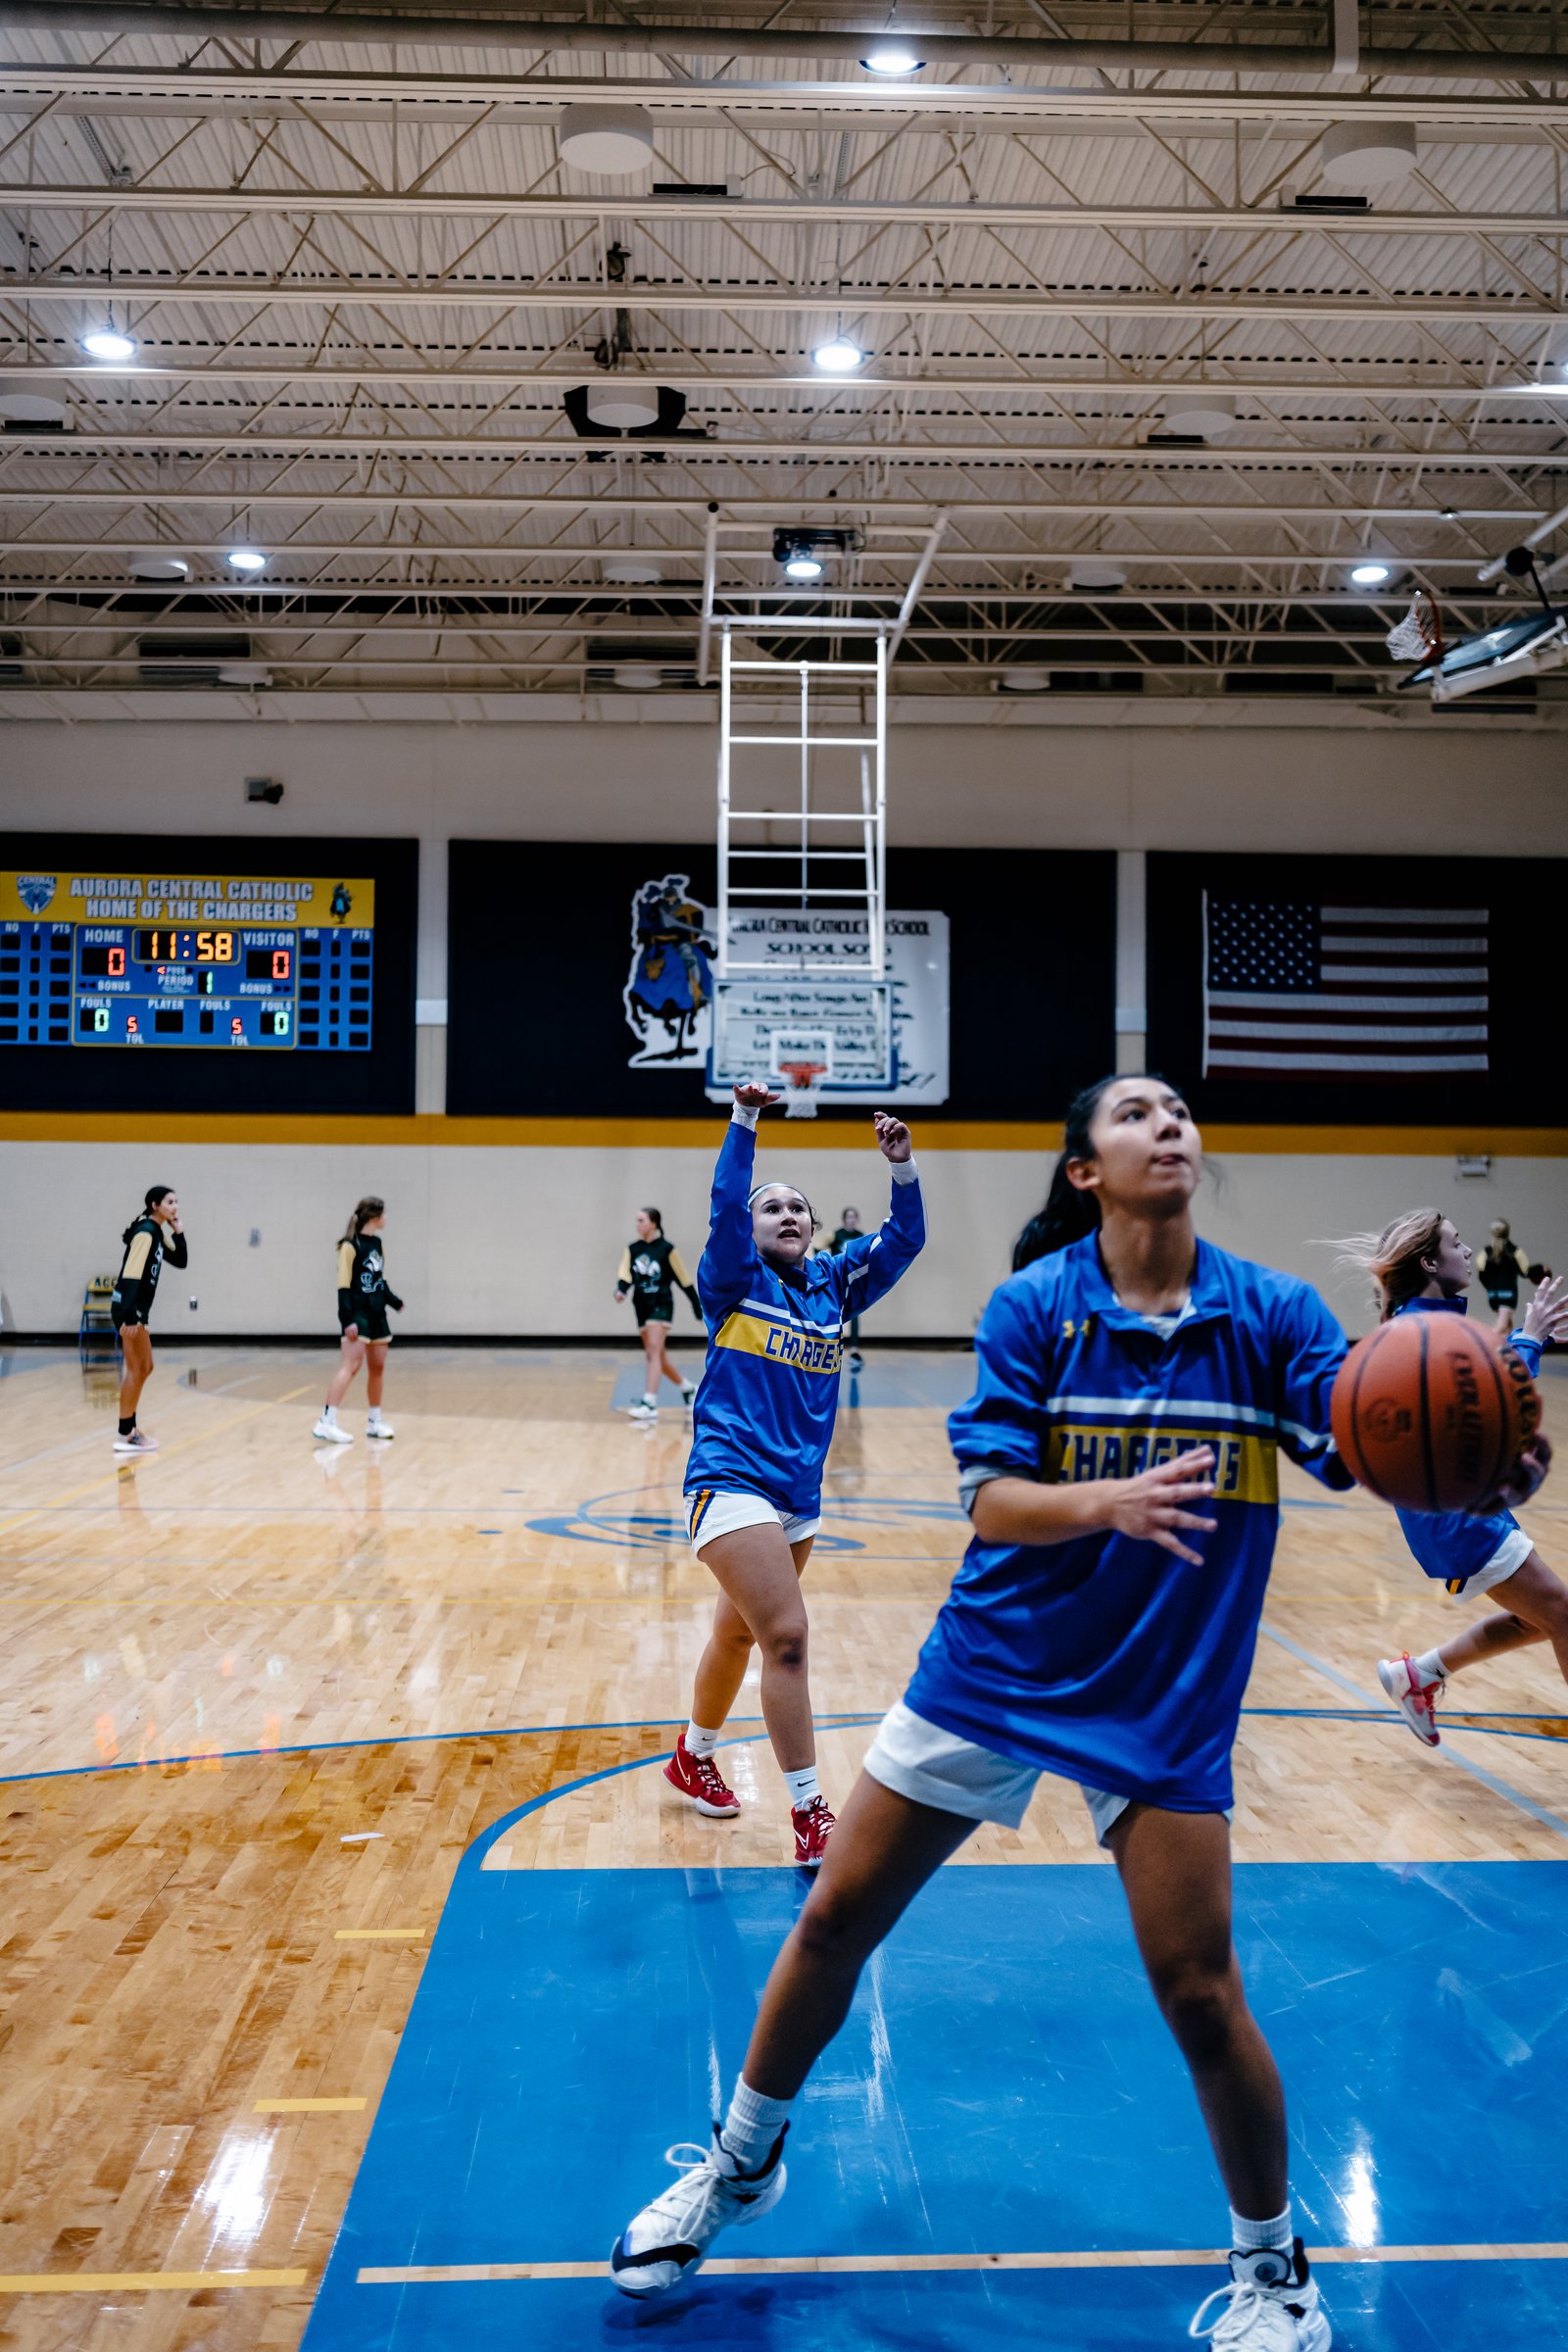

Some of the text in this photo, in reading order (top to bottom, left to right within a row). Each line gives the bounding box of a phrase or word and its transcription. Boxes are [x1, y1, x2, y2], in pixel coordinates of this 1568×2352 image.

[70, 878, 314, 902] AURORA CENTRAL CATHOLIC
[86, 900, 297, 921] HOME OF THE CHARGERS
[52, 923, 71, 934] PTS
[352, 930, 370, 940] PTS
[84, 928, 123, 943] HOME
[243, 932, 294, 947] VISITOR
[151, 931, 233, 961] 11:58
[766, 942, 834, 956] SCHOOL
[108, 948, 125, 976] 0
[272, 951, 290, 979] 0
[98, 980, 130, 992] BONUS
[158, 974, 194, 986] PERIOD
[206, 971, 214, 995] 1
[240, 983, 272, 994] BONUS
[80, 998, 111, 1008] FOULS
[148, 999, 184, 1010] PLAYER
[200, 1001, 230, 1011] FOULS
[262, 1002, 291, 1011] FOULS
[94, 1007, 110, 1032] 0
[273, 1011, 289, 1036] 0
[125, 1034, 144, 1045] TOL
[231, 1035, 249, 1046] TOL
